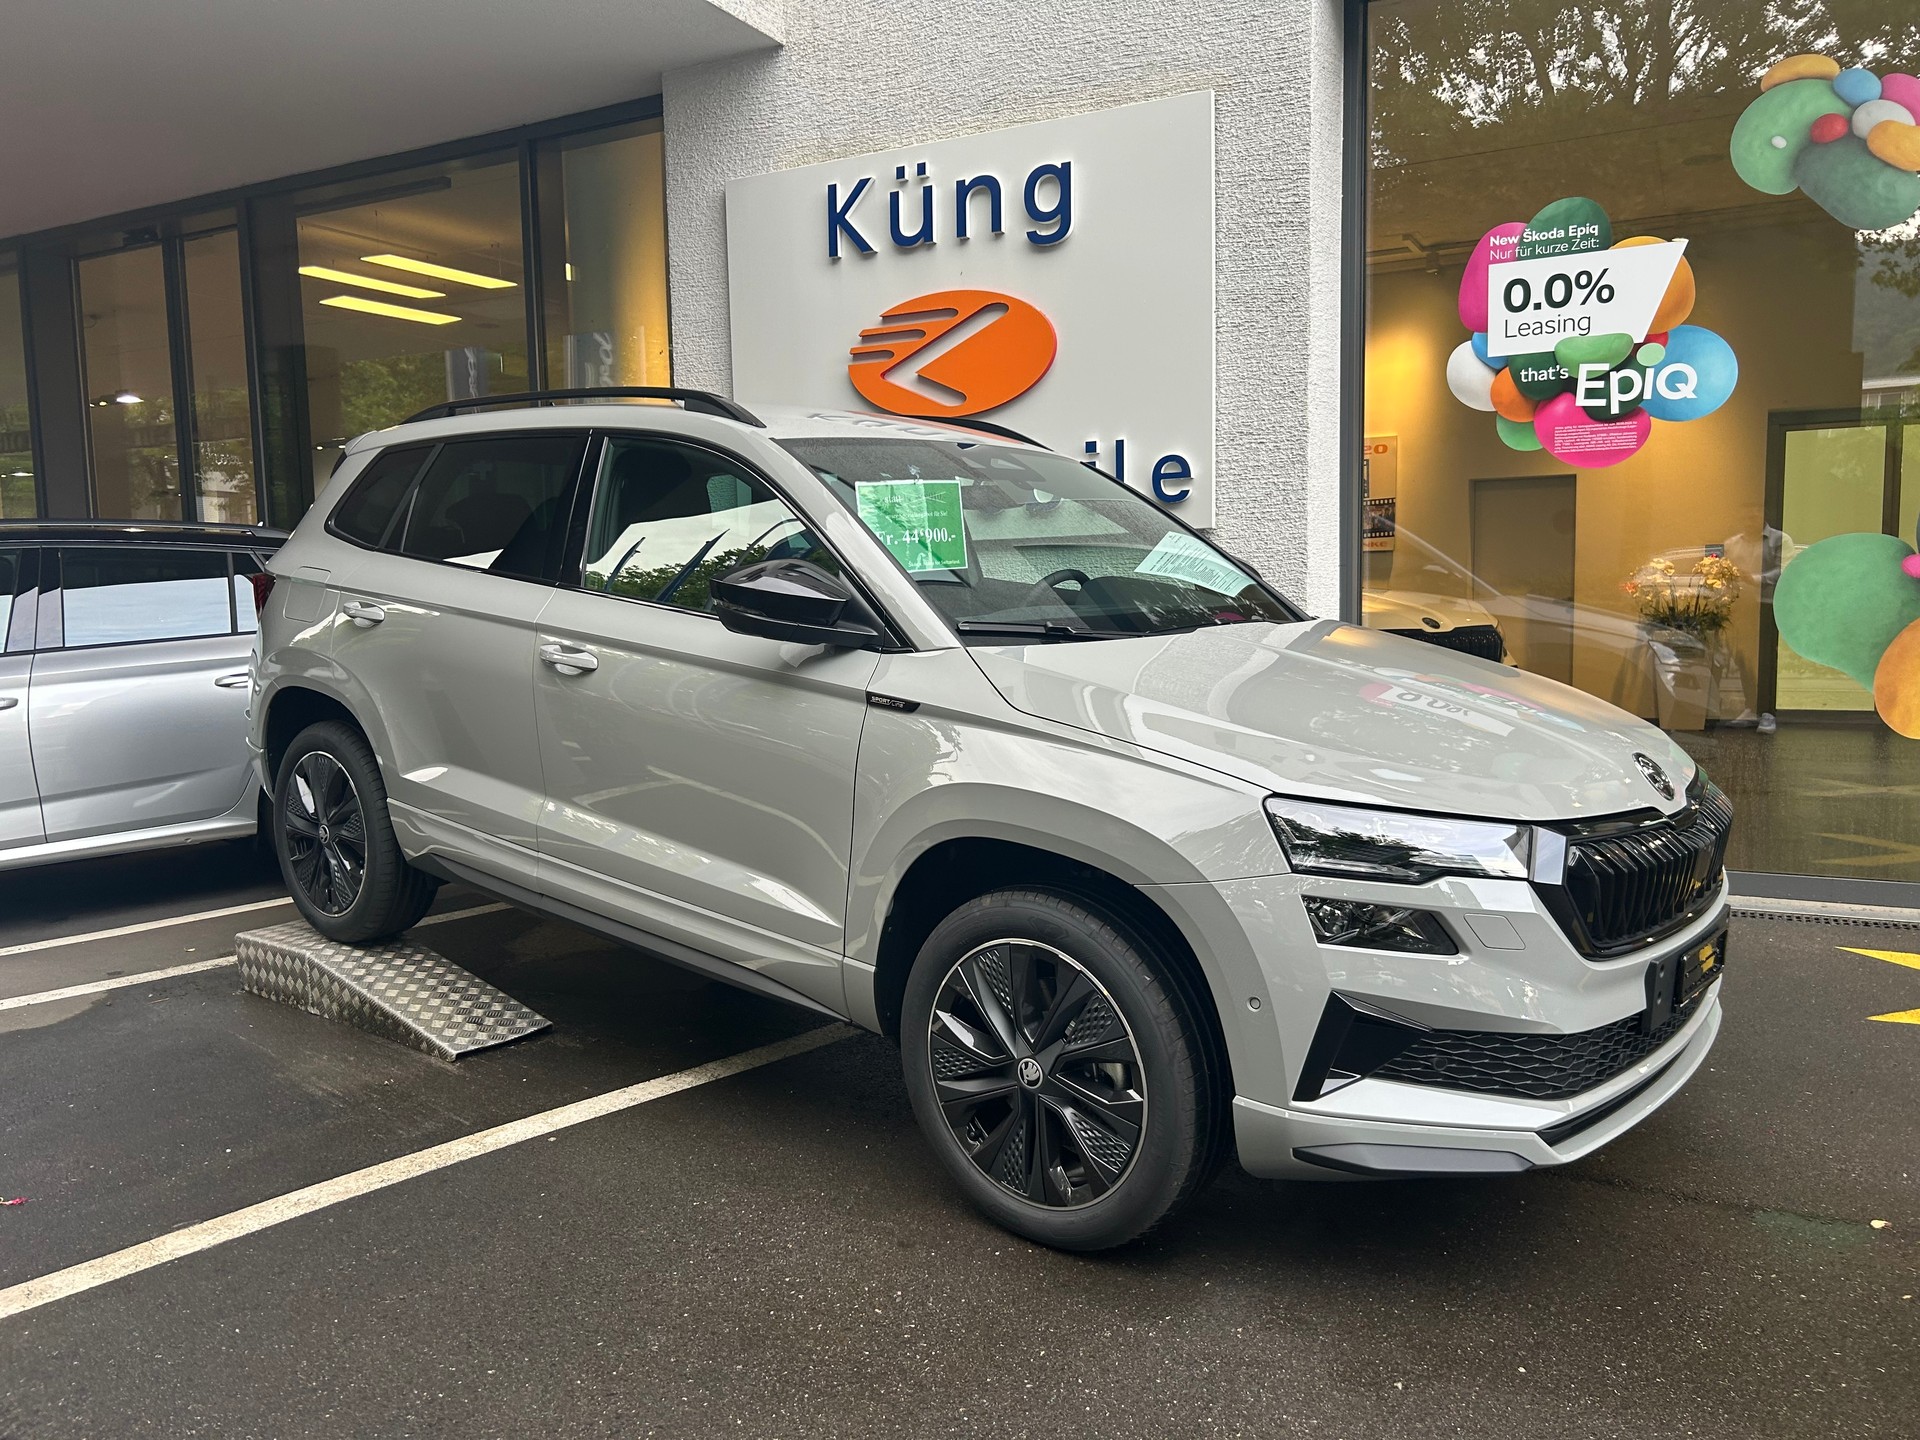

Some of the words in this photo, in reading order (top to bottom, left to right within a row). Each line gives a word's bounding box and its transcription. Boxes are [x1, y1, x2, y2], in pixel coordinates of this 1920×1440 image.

[827, 161, 1074, 259] Küng
[1489, 234, 1520, 247] New
[1522, 228, 1565, 243] Škoda
[1568, 223, 1599, 240] Epiq
[1489, 248, 1514, 261] Nur
[1514, 245, 1533, 258] für
[1535, 241, 1568, 255] kurze
[1571, 237, 1600, 250] Zeit:
[1503, 267, 1615, 313] 0.0%
[1504, 313, 1591, 339] Leasing
[1520, 365, 1569, 382] that's
